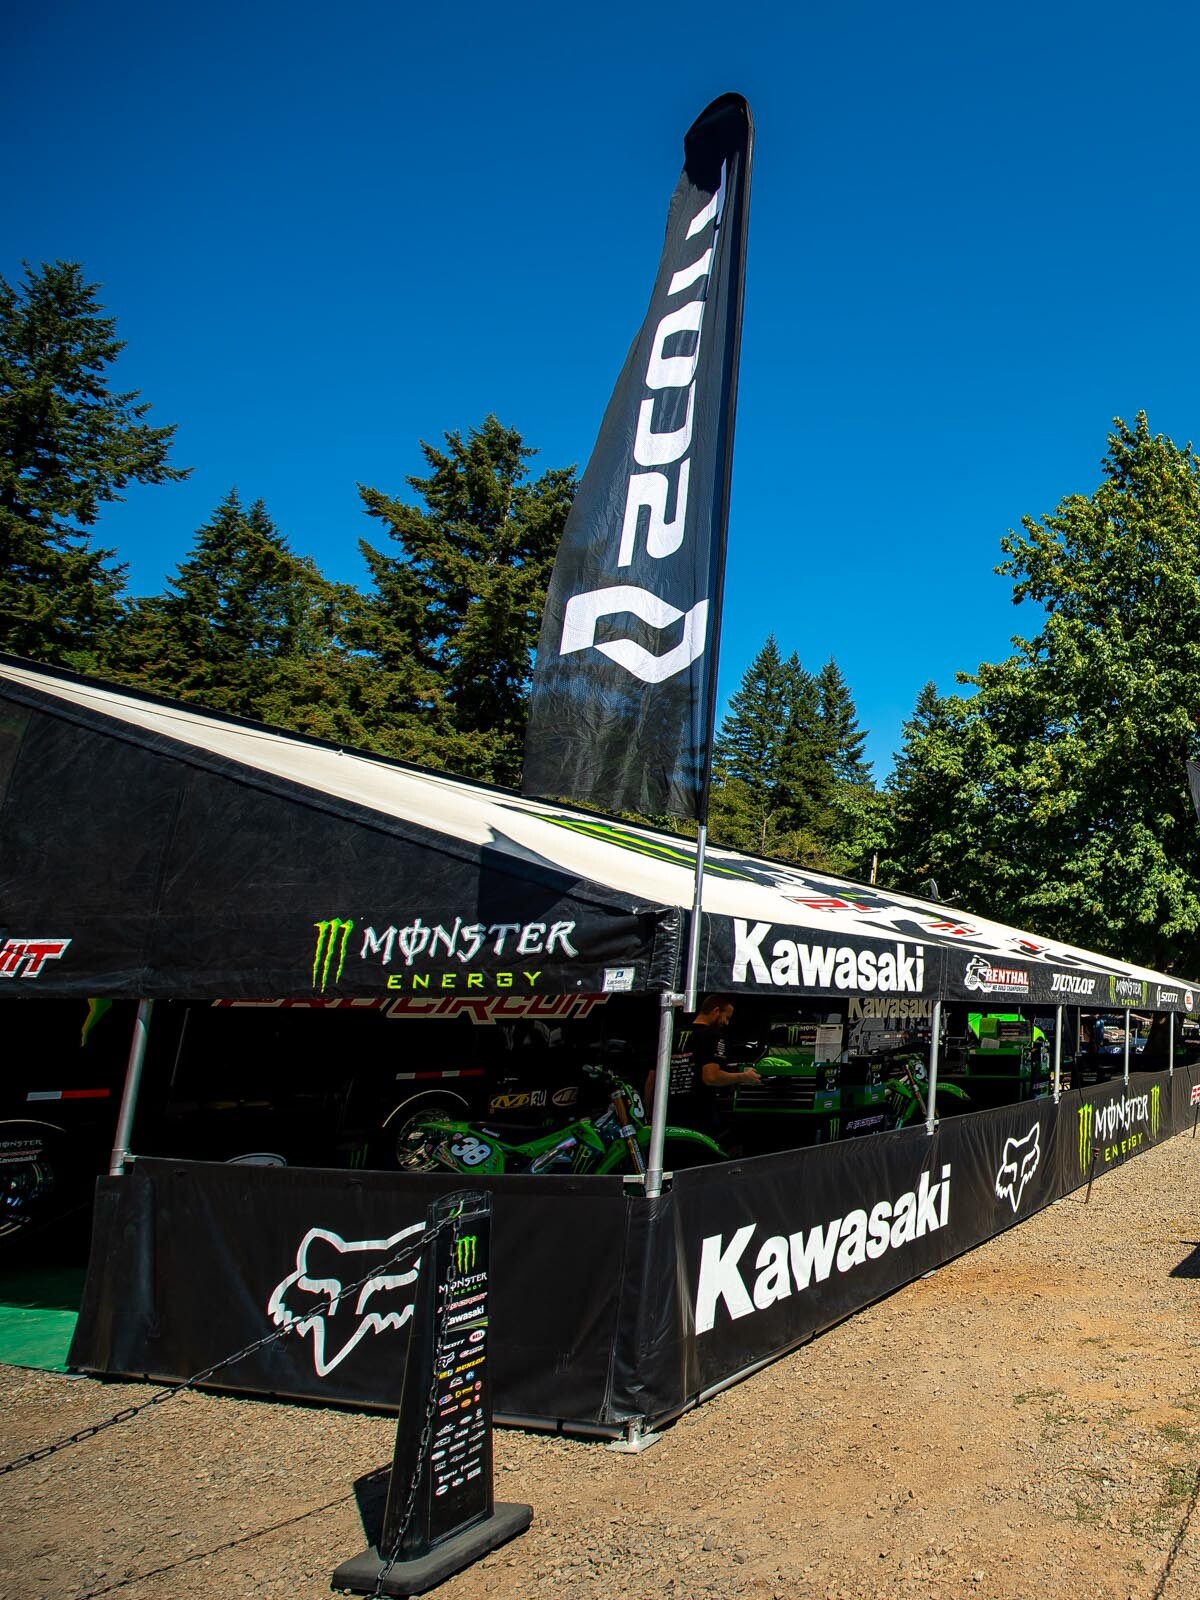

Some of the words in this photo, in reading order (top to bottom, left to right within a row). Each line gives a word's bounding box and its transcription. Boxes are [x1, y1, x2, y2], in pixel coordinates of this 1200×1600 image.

[361, 917, 578, 966] MONSTER
[732, 918, 925, 992] Kawasaki
[387, 971, 543, 990] ENERGY
[984, 968, 1029, 985] RENTHAL
[1051, 973, 1096, 995] DUNLOP
[1115, 979, 1142, 998] MONSTER
[1160, 992, 1178, 1003] SCOTT
[1094, 1094, 1149, 1142] MONSTER
[450, 1134, 492, 1167] 38
[694, 1163, 952, 1336] Kawasaki
[455, 1356, 486, 1374] DUNLOP
